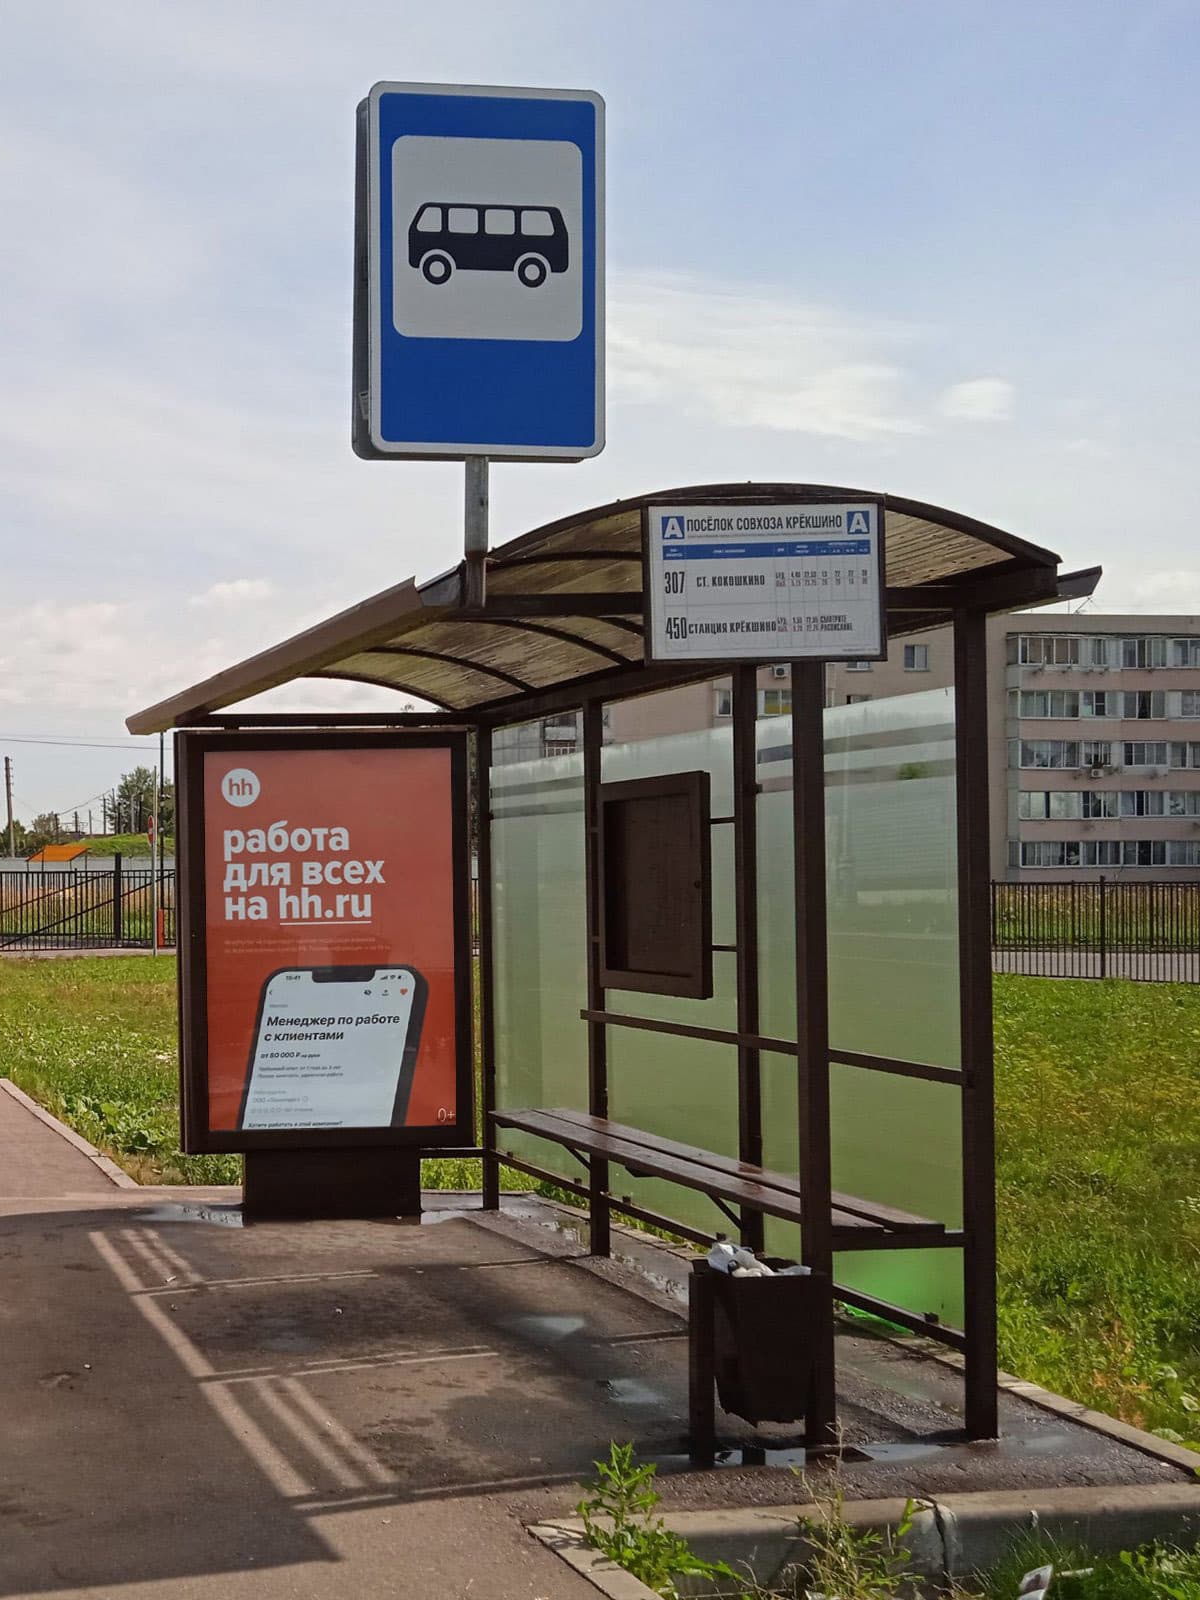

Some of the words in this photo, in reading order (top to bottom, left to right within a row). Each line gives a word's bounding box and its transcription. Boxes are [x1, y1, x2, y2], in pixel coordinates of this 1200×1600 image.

[687, 516, 734, 531] ПОСЁЛОК
[736, 517, 783, 530] СОВХОЗА
[786, 513, 842, 529] КРЁКШИНО
[664, 571, 685, 594] 307
[696, 576, 710, 587] СТ.
[711, 575, 765, 587] КОКОШКИНО
[666, 617, 688, 640] 450
[688, 622, 728, 635] СТАНЦИЯ
[729, 620, 777, 633] КРЁКШИНО
[228, 778, 253, 796] hh
[223, 820, 350, 861] работа
[223, 861, 291, 892] для
[302, 860, 386, 885] всех
[225, 895, 268, 920] на
[279, 887, 372, 920] hh.ru
[266, 1016, 335, 1027] Менеджер
[337, 1017, 353, 1025] по
[355, 1013, 400, 1027] работе
[264, 1032, 272, 1042] с
[273, 1031, 344, 1042] клиентами
[437, 1107, 456, 1122] 0+
